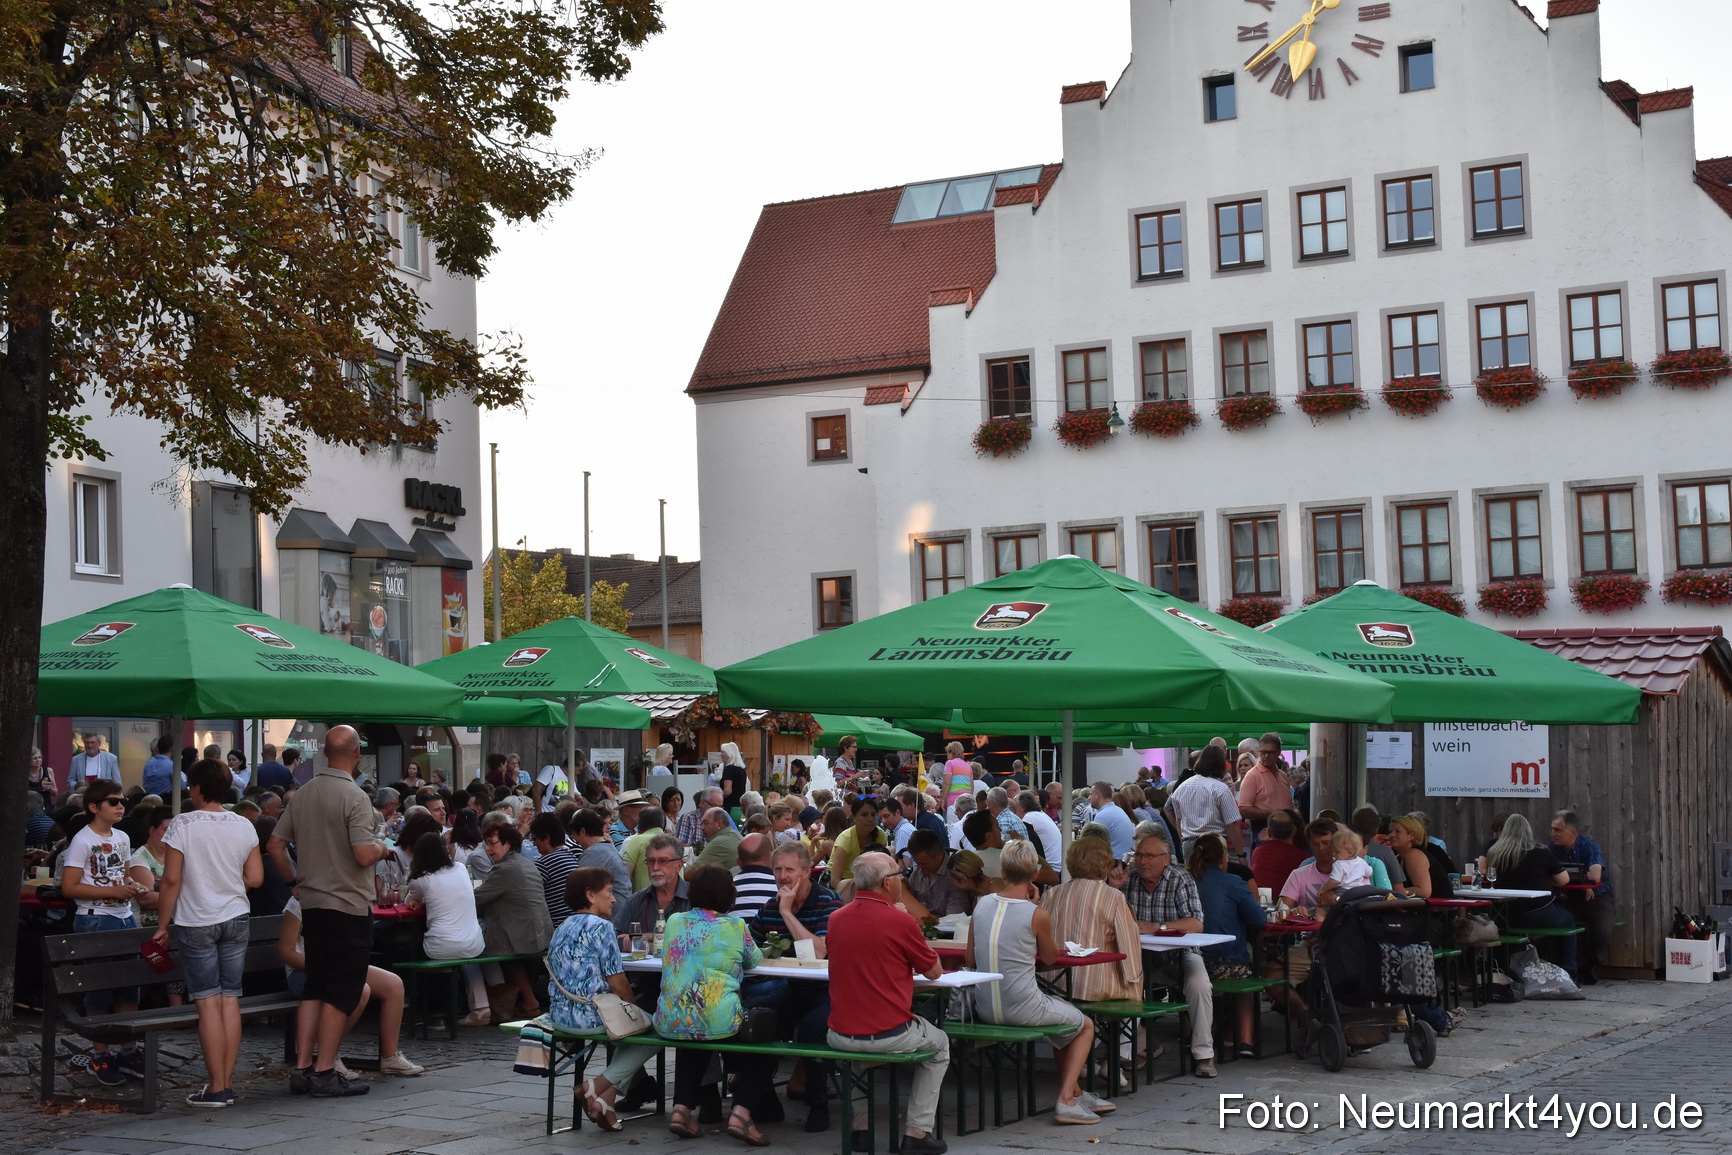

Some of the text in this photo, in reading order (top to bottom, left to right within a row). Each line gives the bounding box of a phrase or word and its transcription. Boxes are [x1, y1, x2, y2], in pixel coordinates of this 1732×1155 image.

[404, 478, 466, 516] RACKL
[385, 576, 405, 596] RACKL
[911, 635, 1060, 647] Neumarkter
[256, 652, 344, 664] Neumarkter
[868, 647, 1074, 661] Lammsbräu
[1331, 651, 1465, 664] Neumarkter
[254, 660, 378, 677] Lammsbräu
[463, 670, 551, 680] Neumarkter
[1348, 662, 1497, 677] mmsbräu
[1432, 738, 1471, 753] wein
